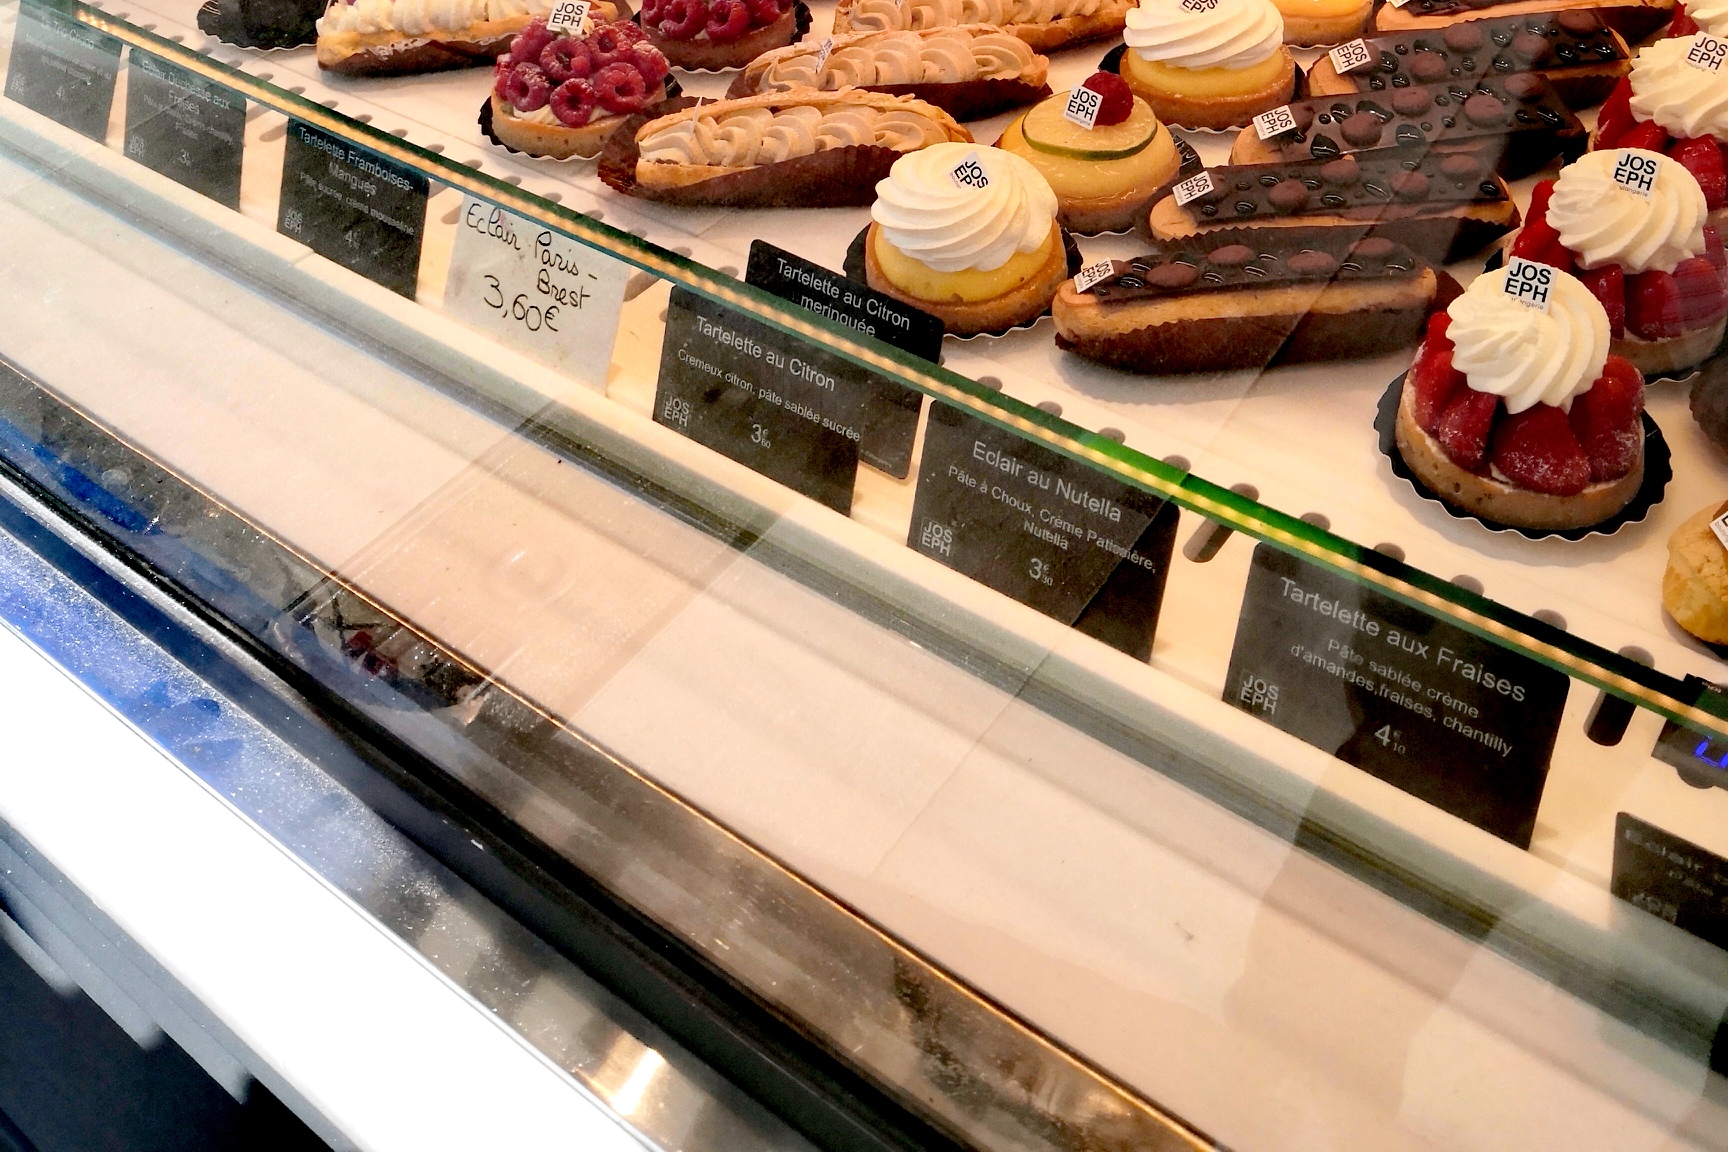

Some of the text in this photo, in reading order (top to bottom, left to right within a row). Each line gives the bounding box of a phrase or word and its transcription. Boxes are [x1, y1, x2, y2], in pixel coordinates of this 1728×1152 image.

[552, 13, 581, 27] EPH
[556, 3, 584, 15] JOS
[1338, 46, 1355, 68] EPH
[1349, 43, 1366, 61] JOS
[1695, 37, 1727, 56] JOS
[1688, 48, 1722, 70] EPH
[214, 95, 230, 110] aux
[1072, 89, 1098, 107] JOS
[1068, 100, 1094, 121] EPH
[1275, 110, 1292, 127] JOS
[1262, 113, 1279, 133] EPH
[300, 127, 344, 160] Tartelette
[954, 165, 975, 186] EP
[965, 161, 988, 188] JOS
[1619, 154, 1656, 175] JOS
[329, 162, 377, 195] Mangues
[1181, 181, 1196, 198] EPH
[1194, 176, 1209, 192] JOS
[1614, 168, 1653, 191] EPH
[284, 219, 301, 234] EPH
[467, 203, 521, 250] Eclair
[1082, 268, 1098, 285] EPH
[1095, 262, 1110, 277] JOS
[1510, 262, 1551, 285] JOS
[537, 269, 590, 309] Brest
[777, 257, 910, 331] Tartelette au Citron
[1505, 278, 1548, 302] EPH
[484, 275, 559, 332] 3,60€
[800, 296, 876, 337] meringuée
[697, 315, 835, 392] Tartelette au Citron
[665, 396, 690, 415] JOS
[678, 349, 722, 379] Cremeux
[758, 387, 783, 406] pâte
[784, 399, 820, 423] sablée
[822, 416, 861, 442] sucrée
[664, 408, 688, 427] EPH
[973, 440, 1122, 523] Eclair au Nutella
[948, 465, 977, 488] Pâte
[980, 480, 988, 494] à
[991, 486, 1035, 518] Choux,
[1039, 508, 1083, 537] Crème
[923, 521, 953, 543] JOS
[1023, 521, 1069, 551] Nutella
[921, 533, 951, 557] EPH
[1280, 576, 1526, 702] Tartelette aux Fraises
[1243, 674, 1280, 701] JOS
[1327, 638, 1479, 719] Pâte sablée crème
[1240, 686, 1277, 715] EPH
[1442, 713, 1513, 758] chantilly
